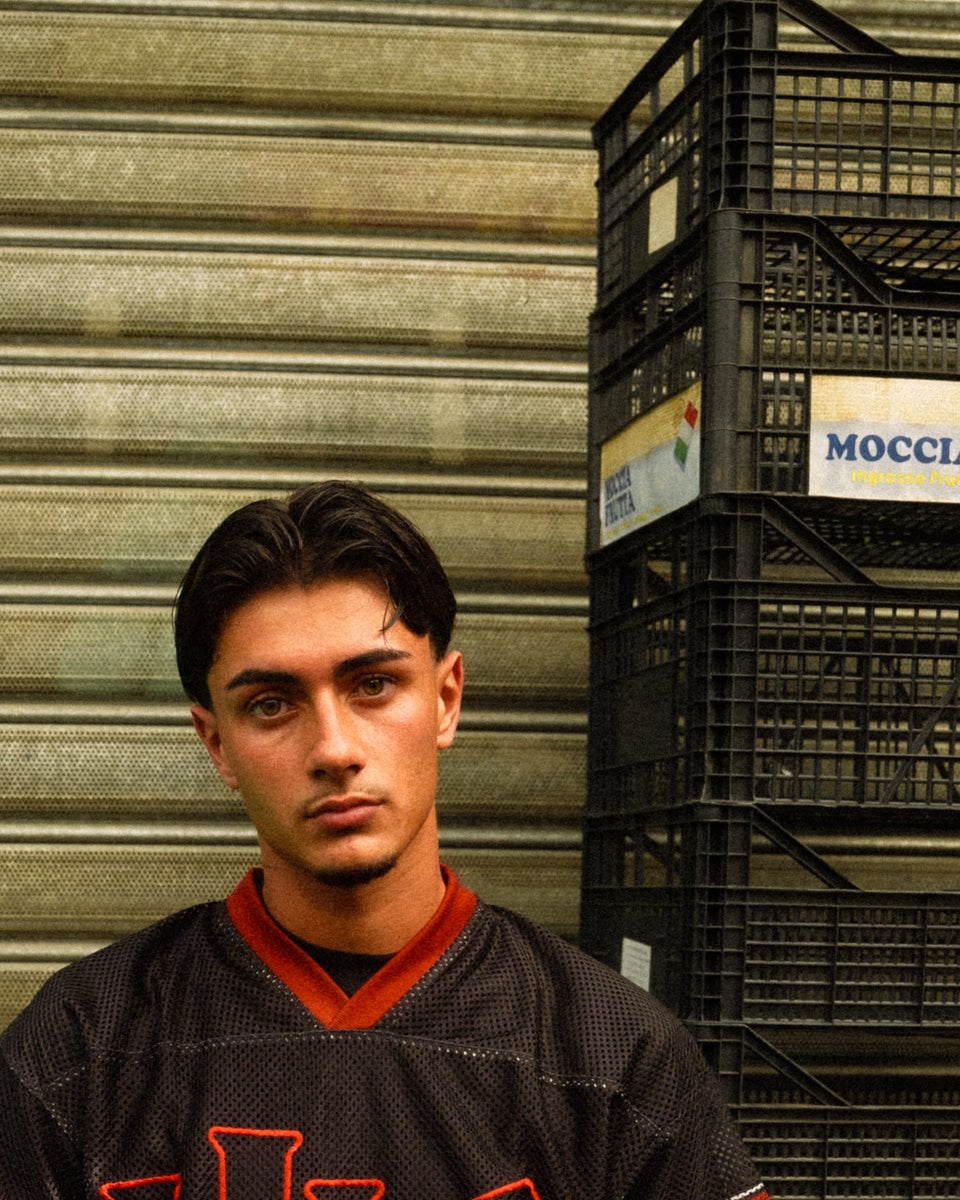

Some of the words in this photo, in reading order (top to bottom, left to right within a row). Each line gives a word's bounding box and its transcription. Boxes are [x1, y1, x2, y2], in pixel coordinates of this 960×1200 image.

[825, 433, 960, 465] MOCCI
[851, 469, 925, 487] Ingrosso
[930, 471, 960, 487] Fru
